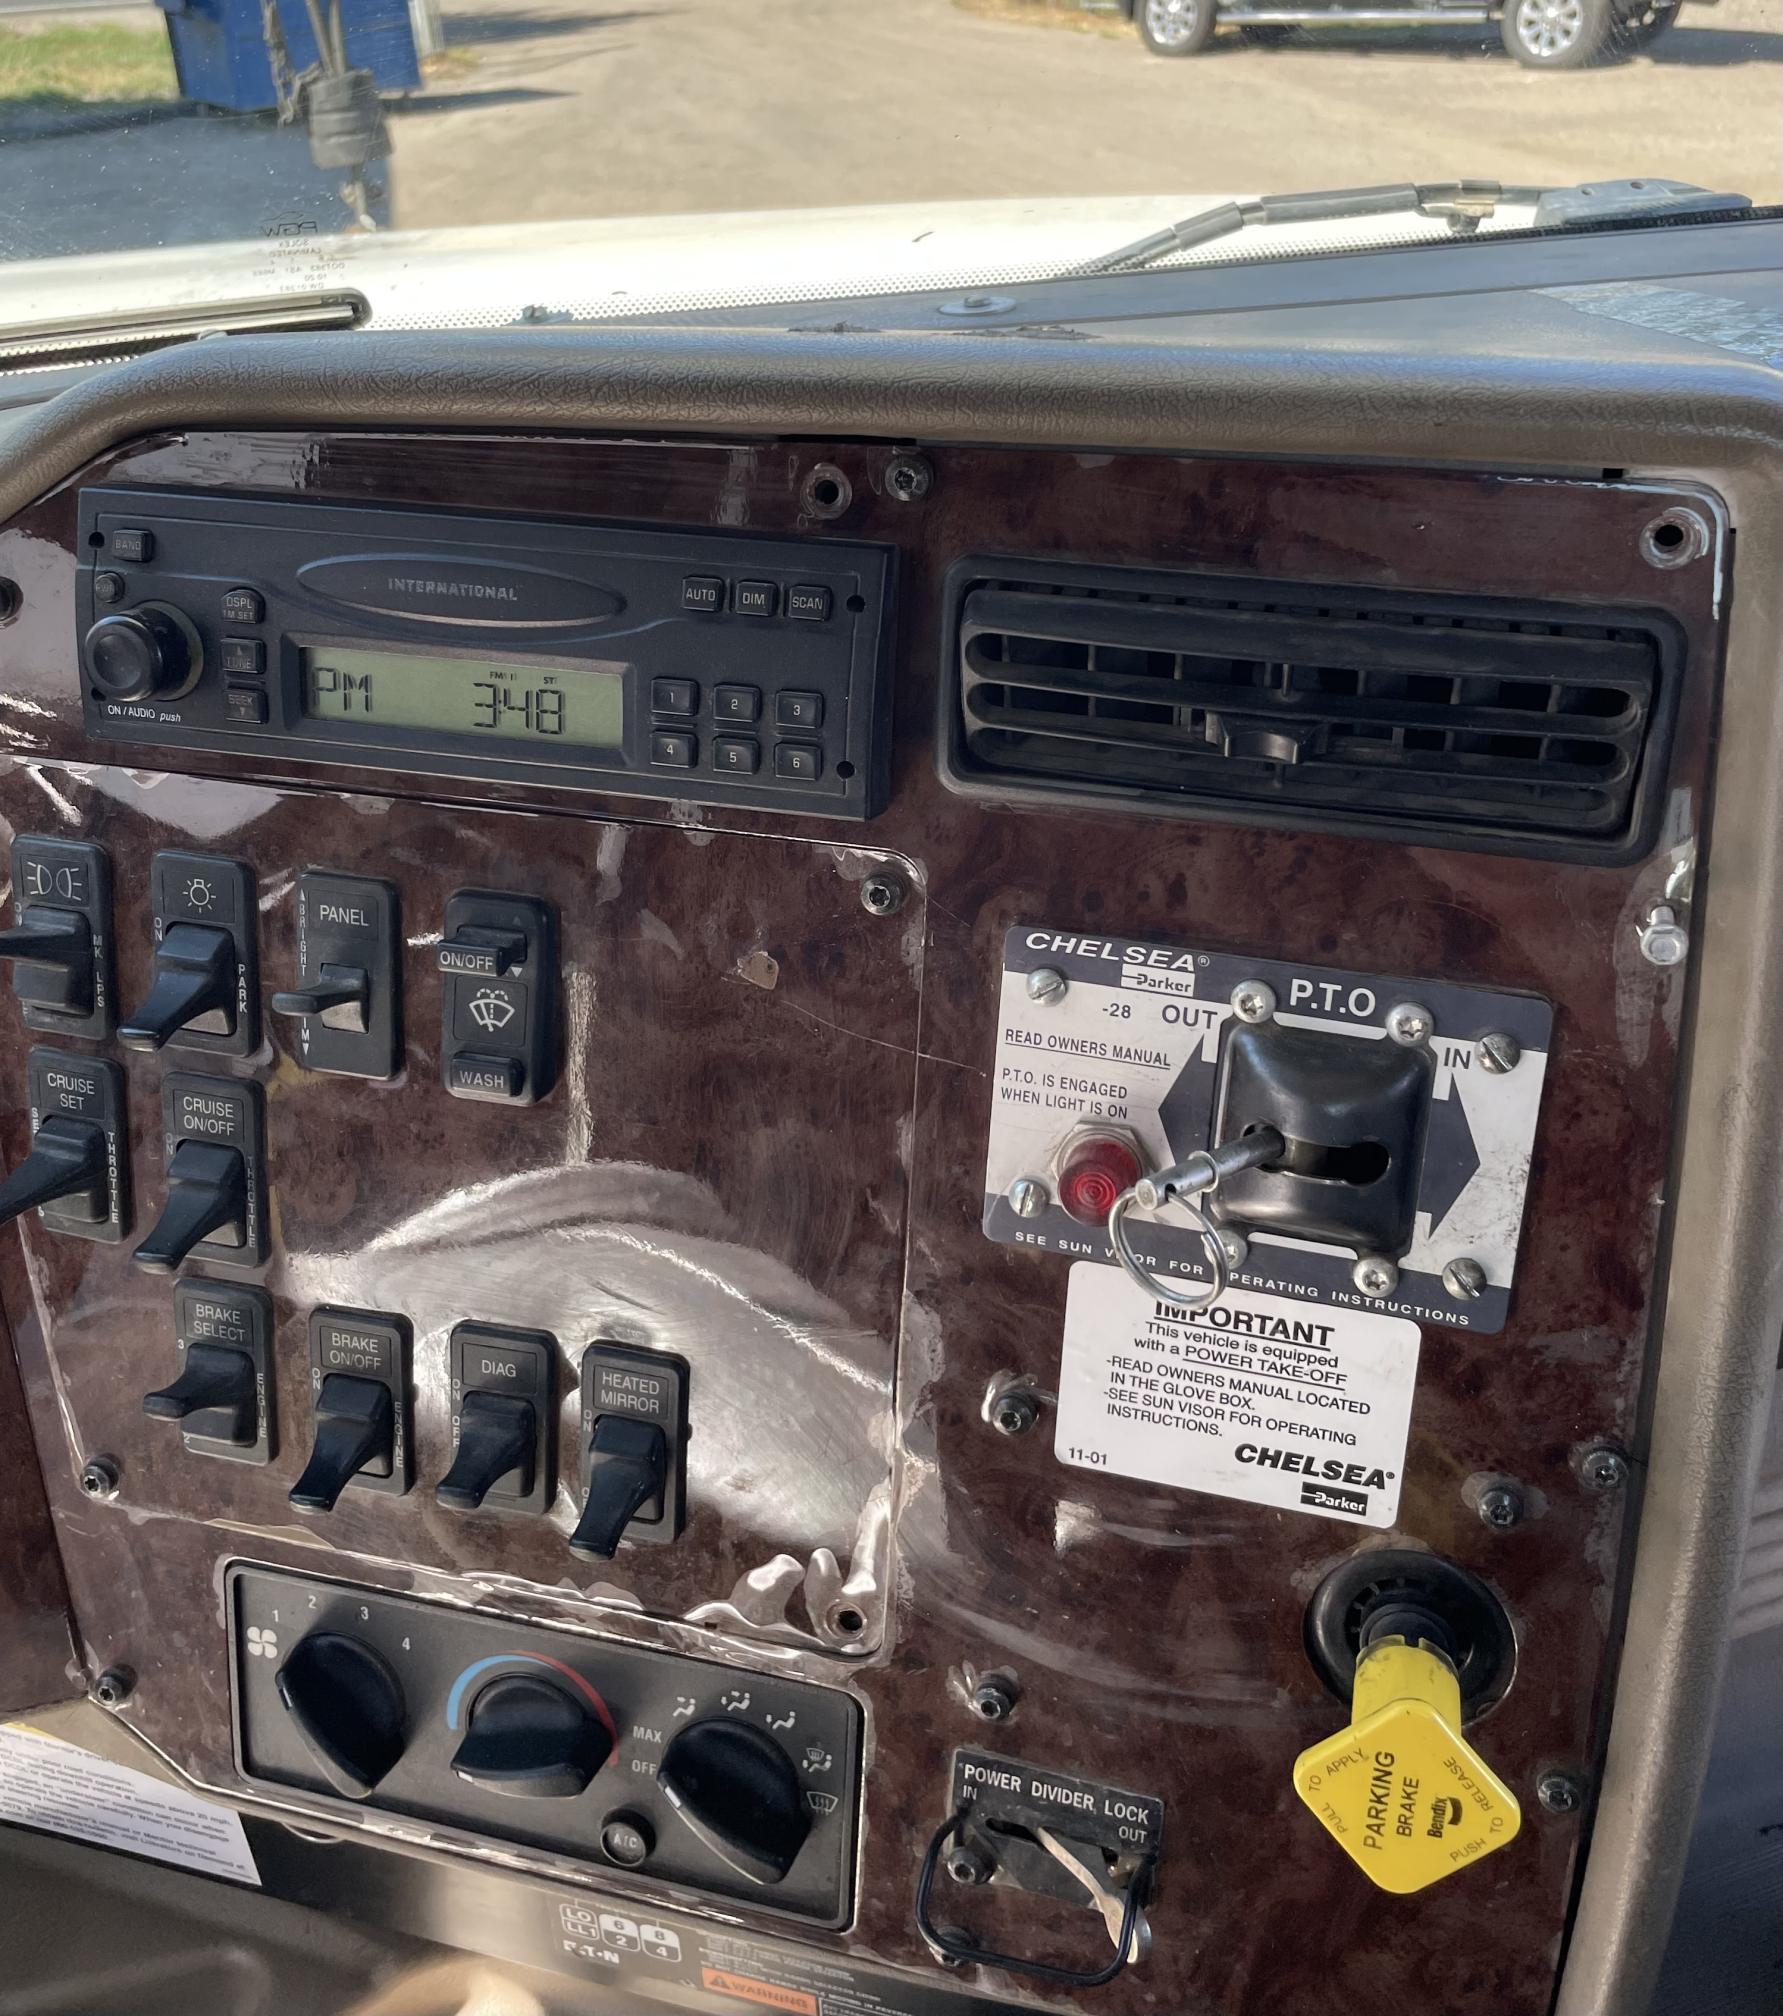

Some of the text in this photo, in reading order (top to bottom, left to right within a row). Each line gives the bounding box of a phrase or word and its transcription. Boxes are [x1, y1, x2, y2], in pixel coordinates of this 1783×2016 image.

[114, 539, 141, 551] BAND
[388, 578, 518, 601] INTERNATIONAL
[685, 586, 717, 603] AUTO
[741, 591, 766, 606] DIM
[226, 596, 253, 610] DSPL
[791, 595, 824, 611] SCAN
[237, 611, 254, 621] SET
[226, 656, 252, 670] TUNE
[227, 693, 254, 706] SEEK
[312, 667, 370, 713] PM
[669, 691, 675, 704] 1
[472, 682, 565, 735] 3:48
[731, 699, 739, 711] 2
[793, 704, 801, 717] 3
[159, 712, 181, 722] push
[666, 744, 674, 756] 4
[729, 752, 737, 764] 5
[793, 757, 801, 770] 6
[319, 904, 369, 928] PANEL
[153, 917, 163, 942] ON
[299, 903, 307, 977] BRIGHT
[439, 950, 494, 970] ON/OFF
[237, 964, 248, 1014] PARK
[1135, 972, 1192, 994] Parker
[1289, 978, 1376, 1018] P.T.O
[1102, 1003, 1132, 1019] -28
[1161, 1003, 1218, 1030] OUT
[1005, 1028, 1171, 1067] READ OWNERS MANUAL
[1443, 1047, 1472, 1070] IN
[47, 1072, 96, 1095] CRUISE
[459, 1070, 505, 1089] WASH
[1002, 1067, 1128, 1099] P.T.O. IS ENGAGED
[59, 1094, 85, 1111] SET
[183, 1096, 235, 1119] CRUISE
[1000, 1087, 1129, 1120] WHEN LIGHT IS ON
[183, 1115, 236, 1138] ON/OFF
[165, 1132, 174, 1155] ON
[107, 1131, 120, 1224] THROTTLE
[1015, 1231, 1470, 1326] SEE SUN VOR FOR PERATING INSTRUCTIONS
[195, 1303, 242, 1325] BRAKE
[193, 1321, 246, 1343] SELECT
[331, 1332, 379, 1353] BRAKE
[177, 1338, 185, 1350] 3
[1145, 1321, 1339, 1369] This vehicle is equipped
[329, 1350, 383, 1371] ON/OFF
[481, 1359, 517, 1378] DIAG
[1134, 1336, 1349, 1387] with a POWER TAKE-OFF
[311, 1367, 321, 1390] ON
[451, 1378, 461, 1402] ON
[601, 1371, 660, 1396] HEATED
[1156, 1364, 1226, 1388] OWNERS
[1228, 1377, 1294, 1402] MANUAL
[1297, 1389, 1371, 1415] LOCATED
[600, 1390, 660, 1414] MIRROR
[1110, 1372, 1256, 1411] IN THE GLOVE BOX.
[256, 1372, 267, 1438] ENGINE
[583, 1409, 593, 1433] ON
[1106, 1403, 1223, 1438] INSTRUCTIONS.
[1141, 1393, 1175, 1412] SUN
[1177, 1401, 1226, 1421] VISOR
[1229, 1410, 1262, 1428] FOR
[1265, 1417, 1357, 1446] OPERATING
[393, 1401, 405, 1468] ENGINE
[451, 1415, 461, 1448] OFF
[1068, 1447, 1108, 1466] 11-01
[1313, 1490, 1367, 1514] Parker
[308, 1595, 317, 1609] 2
[360, 1606, 369, 1620] 3
[272, 1609, 279, 1623] 1
[402, 1637, 411, 1651] 4
[633, 1725, 663, 1744] MAX
[631, 1759, 657, 1775] OFF
[962, 1784, 978, 1801] IN
[963, 1763, 1149, 1825] POWER DIVIDER LOCK
[1308, 1748, 1366, 1835] PULL TO APPLY
[1363, 1750, 1395, 1850] PARKING
[1396, 1776, 1420, 1838] BRAKE
[1427, 1796, 1449, 1839] Bendix
[1443, 1756, 1504, 1863] PUSH TO RELEASE
[613, 1833, 638, 1849] A/C
[1117, 1825, 1148, 1844] OUT
[566, 1907, 592, 1922] LO
[614, 1920, 625, 1931] 6
[616, 1935, 628, 1946] 2
[656, 1946, 668, 1957] 4
[729, 1980, 809, 2009] WARNING
